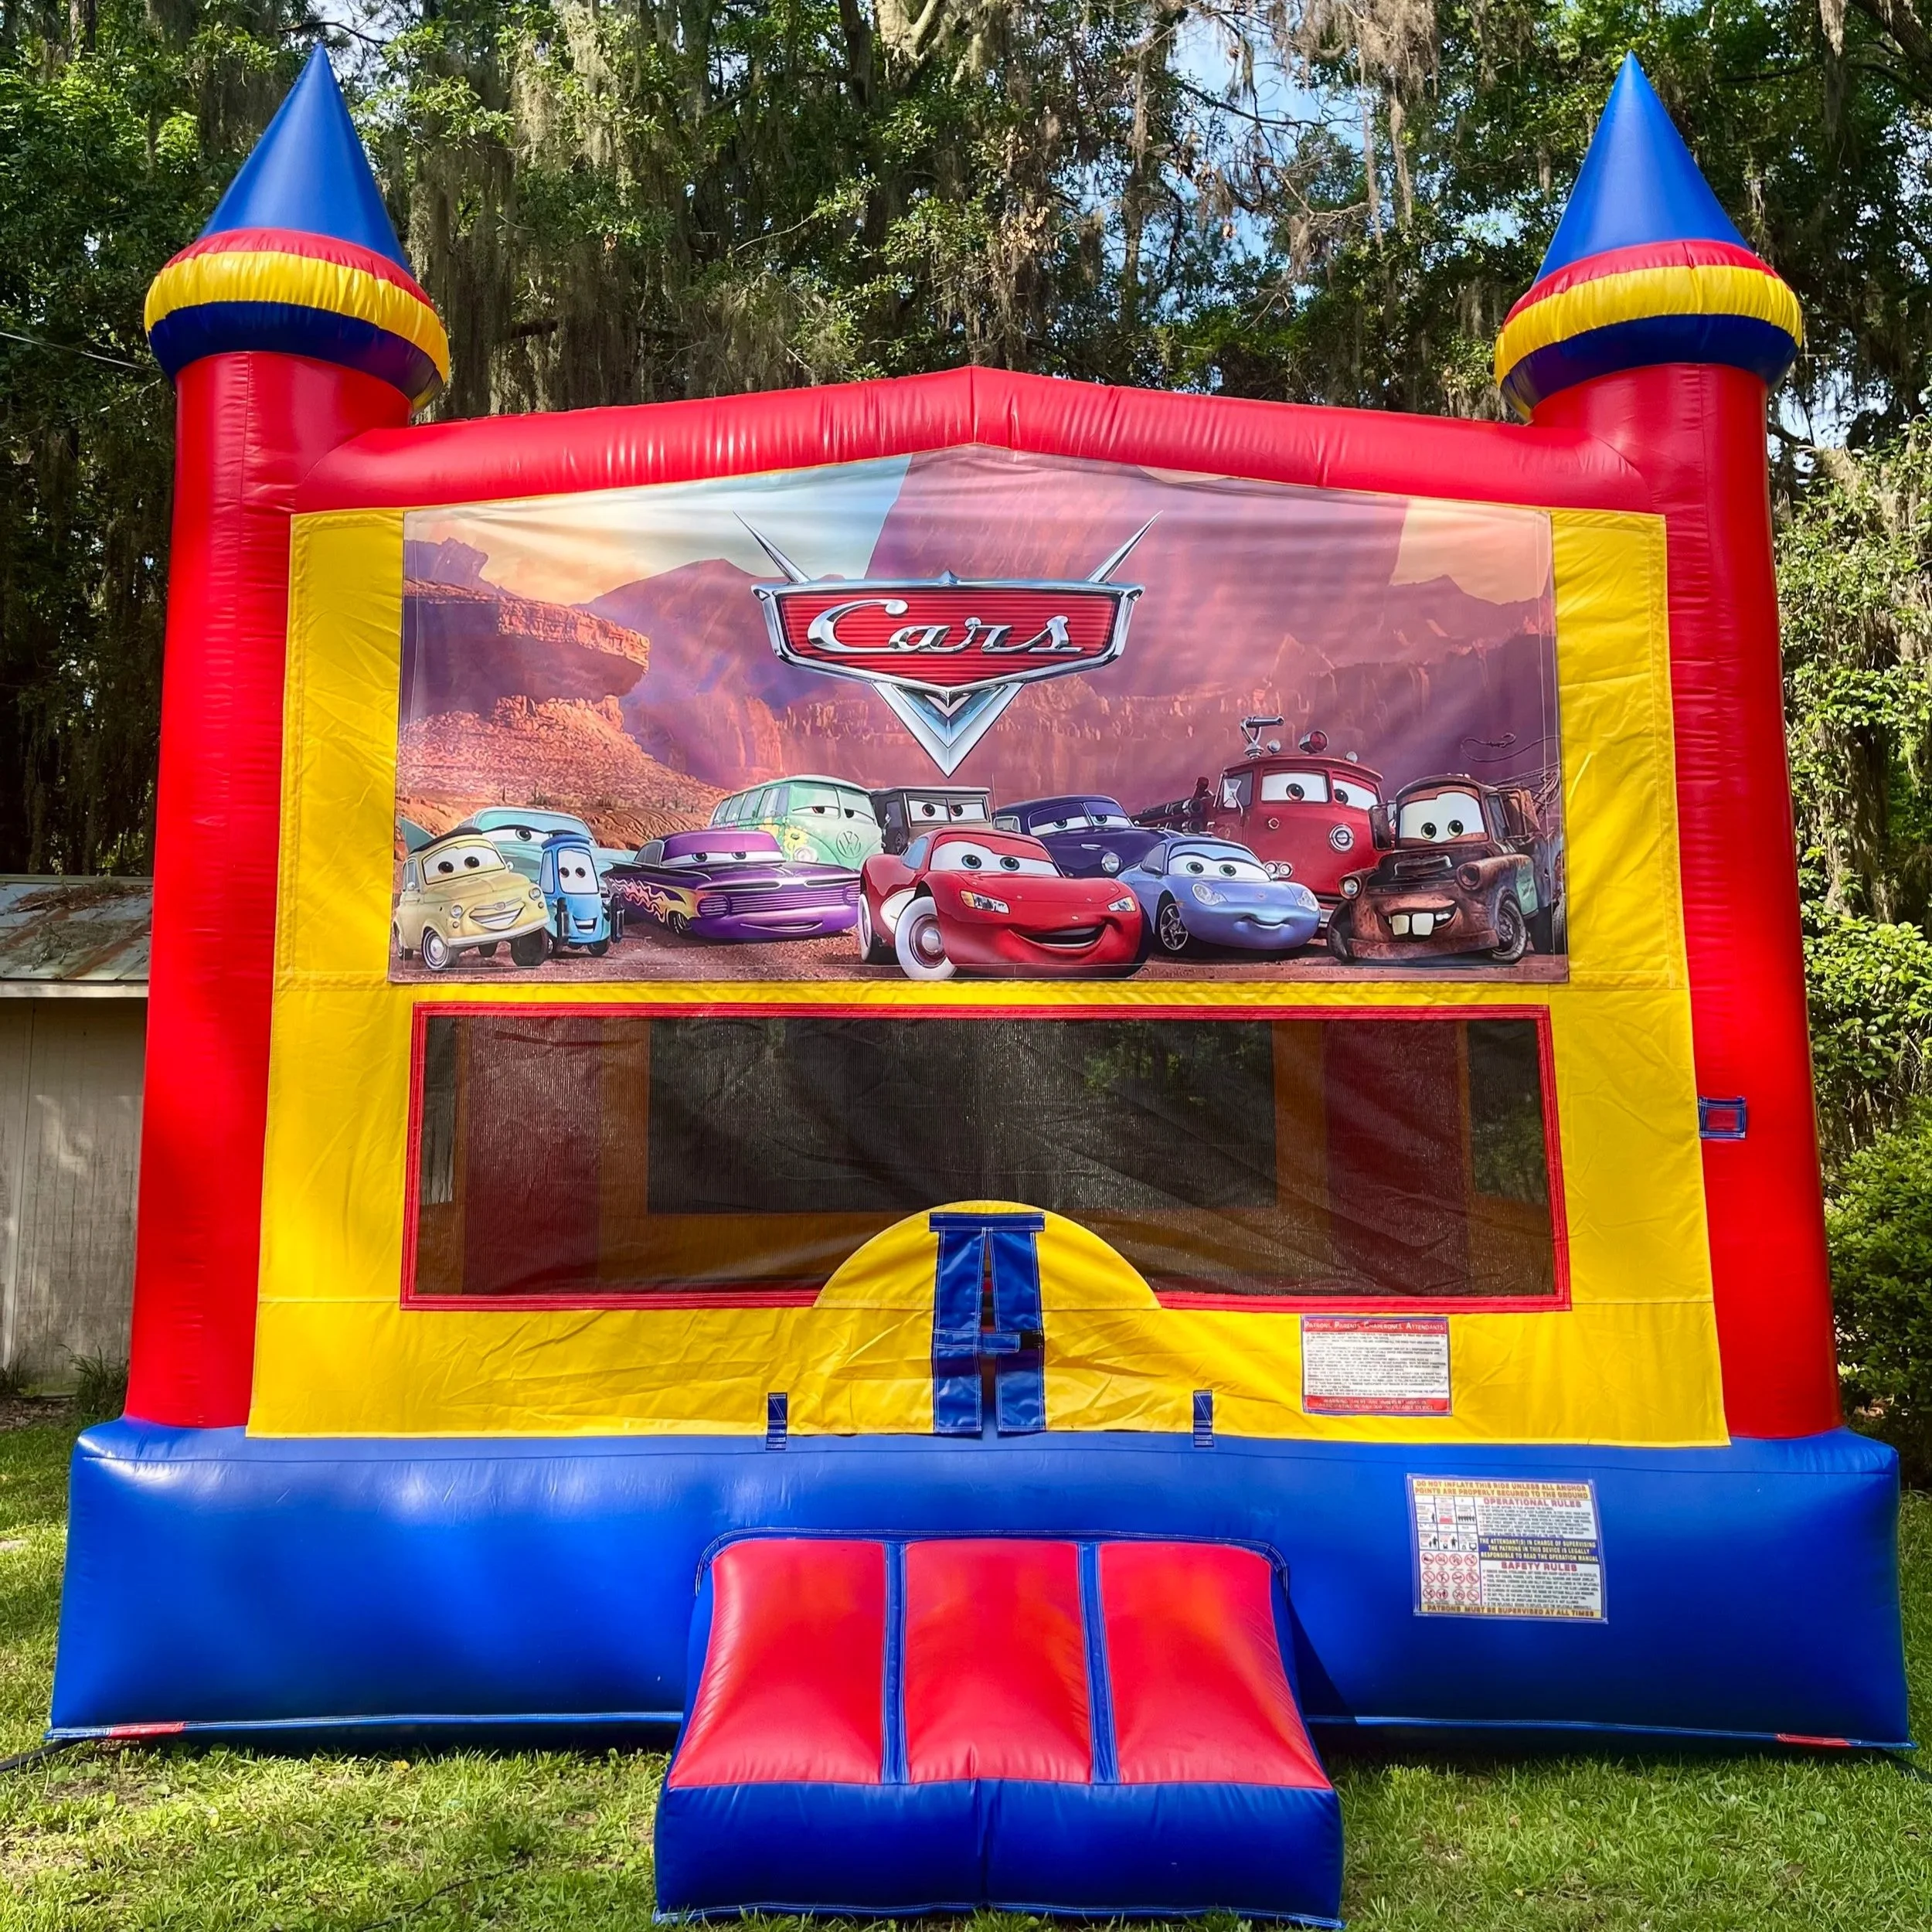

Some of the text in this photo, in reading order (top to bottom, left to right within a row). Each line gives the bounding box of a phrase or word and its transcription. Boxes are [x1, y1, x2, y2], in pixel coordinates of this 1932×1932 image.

[808, 599, 1083, 655] Cars
[1483, 1498, 1549, 1507] OPERATIONAL
[1543, 1563, 1577, 1572] RULES
